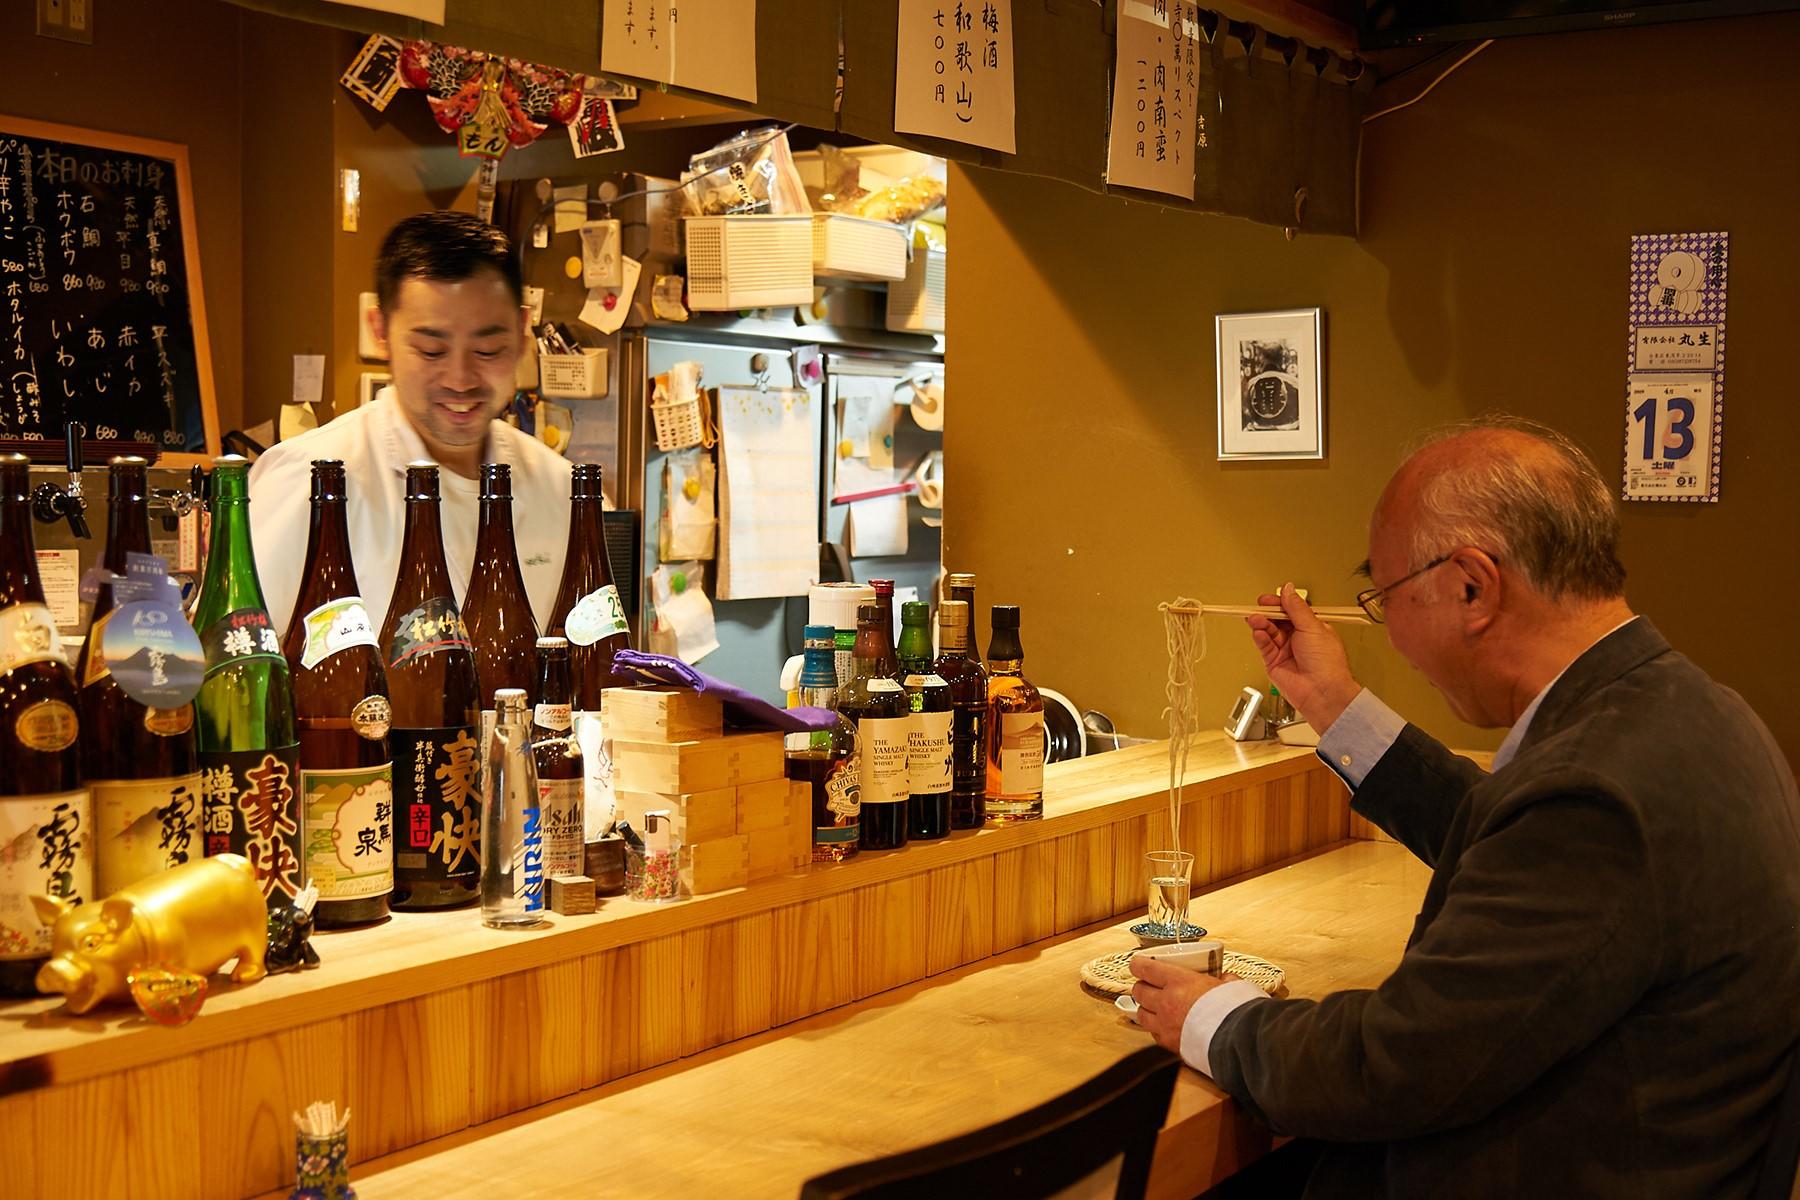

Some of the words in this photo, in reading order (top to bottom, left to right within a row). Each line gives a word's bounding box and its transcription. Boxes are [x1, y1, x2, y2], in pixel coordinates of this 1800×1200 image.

[982, 2, 999, 69] 梅酒
[36, 146, 167, 191] 本日のお刺身
[465, 130, 505, 152] もん
[57, 189, 77, 266] ホウボウ
[80, 195, 101, 249] 石鯛
[2, 258, 25, 273] 580
[7, 281, 25, 361] ホタルイカ
[1677, 331, 1712, 347] 丸生
[51, 318, 76, 399] いわし
[87, 327, 111, 393] あじ
[118, 325, 142, 397] 赤イカ
[95, 424, 118, 440] 680
[1633, 397, 1695, 461] 13
[1651, 461, 1675, 470] 土曜
[201, 764, 239, 835] 樽酒
[428, 729, 482, 873] 豪快
[830, 773, 858, 792] CHIVAS
[237, 753, 299, 901] 豪快
[353, 826, 383, 858] 泉
[411, 807, 429, 844] 辛口
[561, 825, 583, 834] ZERO
[523, 807, 544, 913] KIRIN
